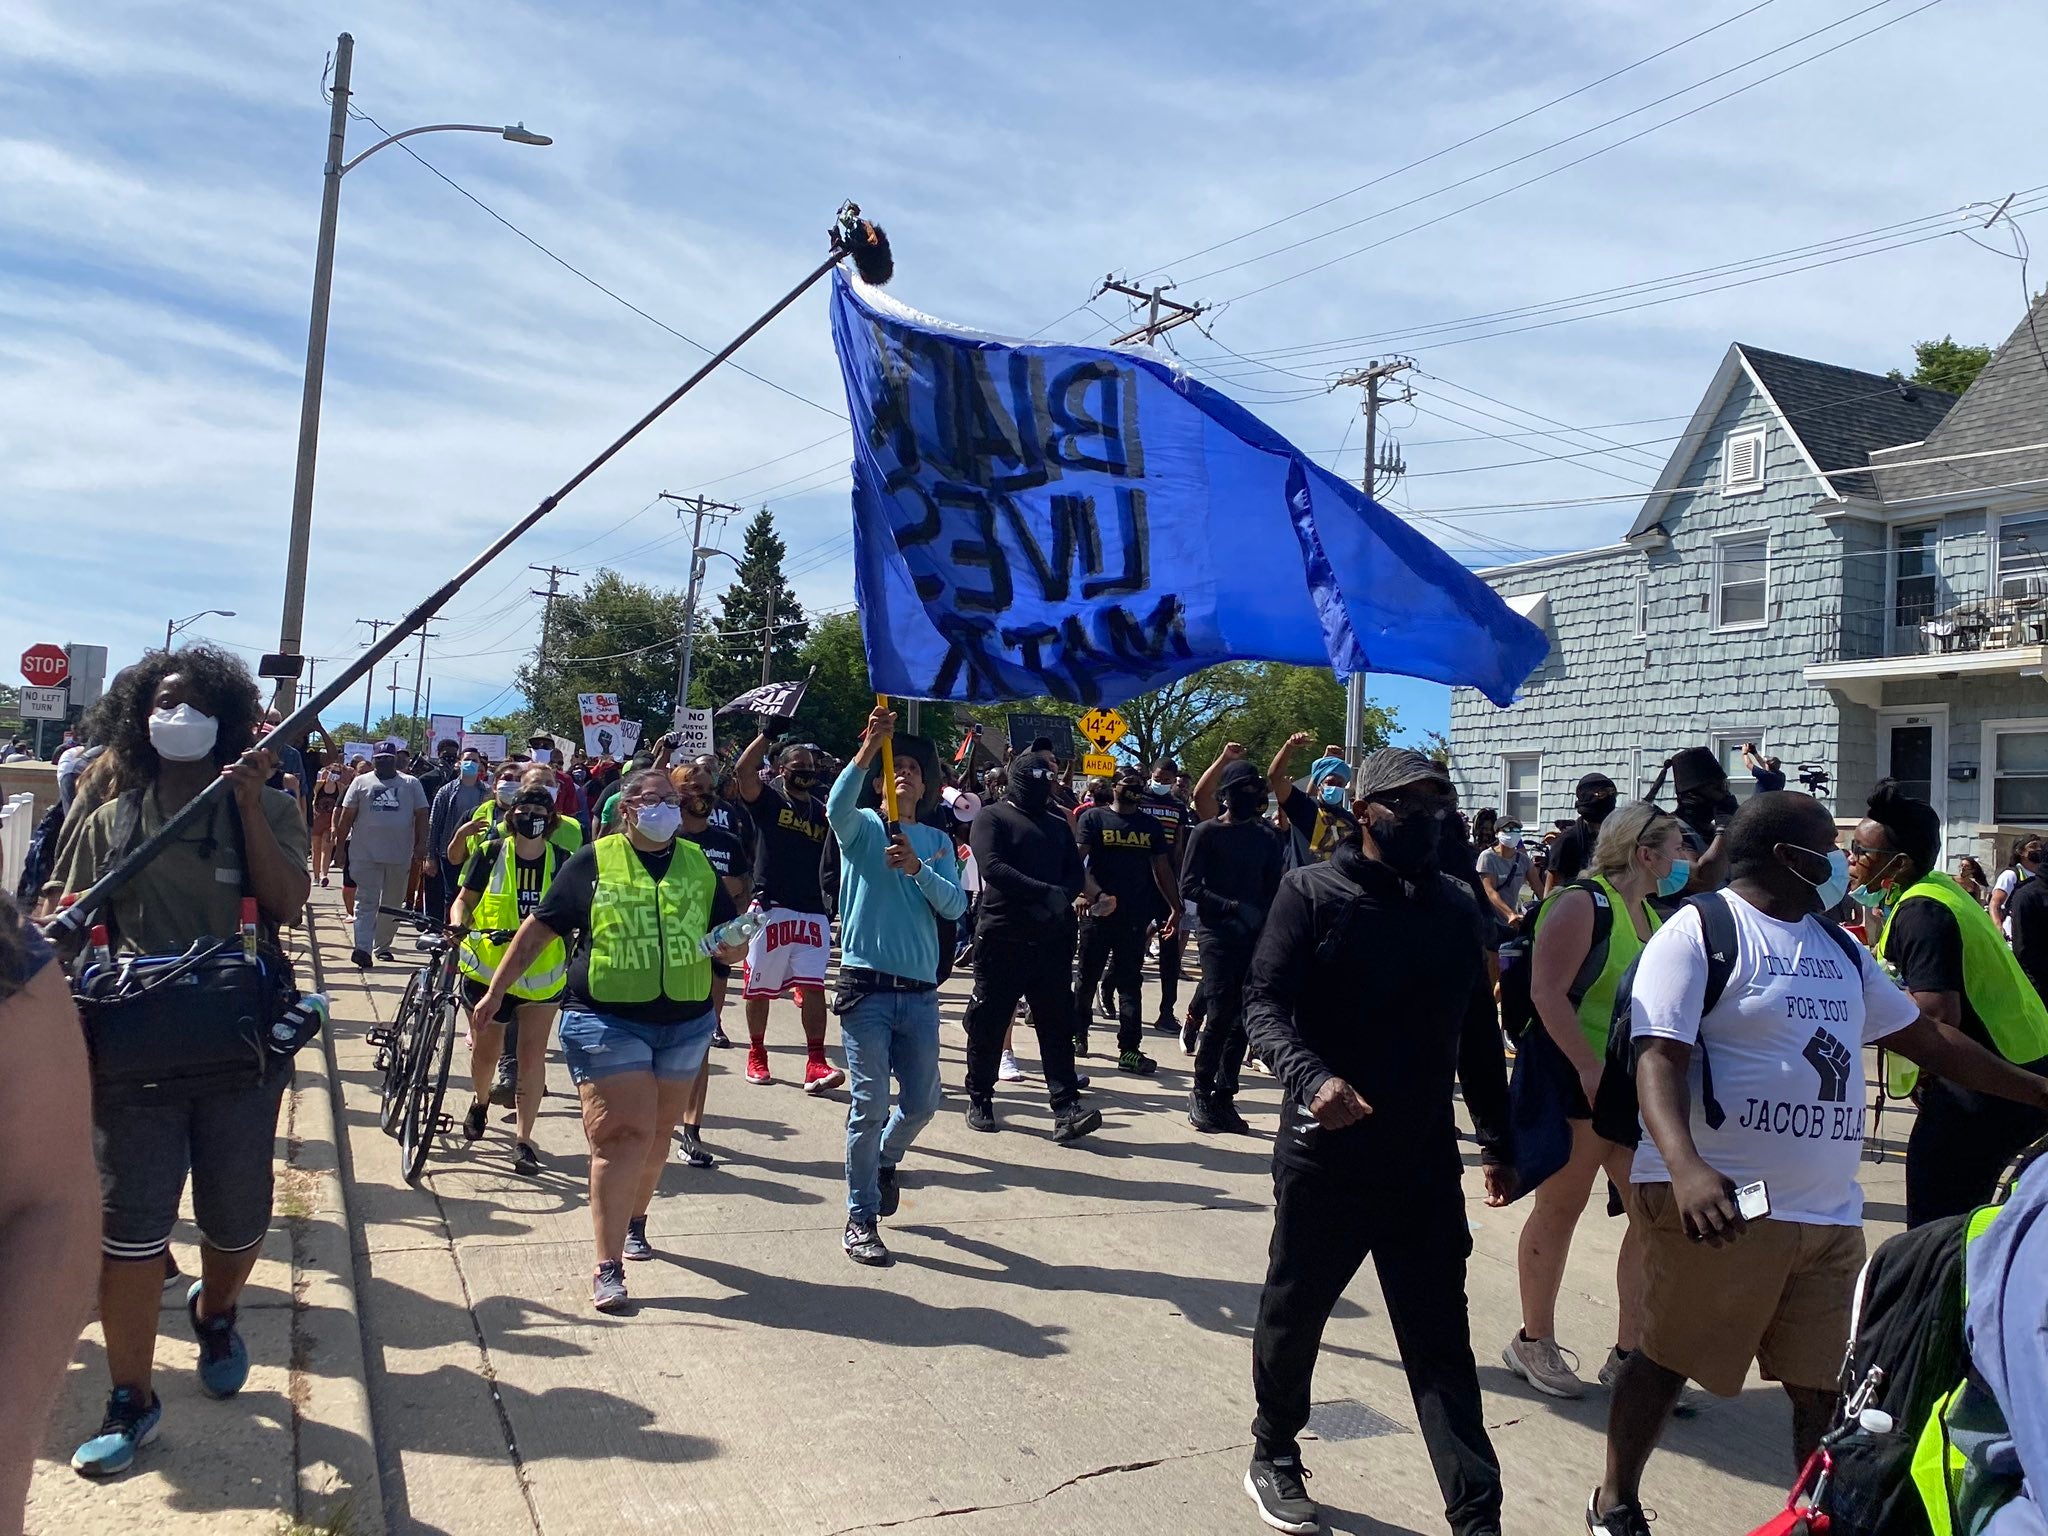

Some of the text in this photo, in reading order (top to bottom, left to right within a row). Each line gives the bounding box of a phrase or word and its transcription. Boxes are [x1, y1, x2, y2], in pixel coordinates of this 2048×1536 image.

[24, 656, 66, 674] STOP
[25, 691, 61, 702] NO LEFT
[580, 696, 594, 705] WE
[31, 703, 53, 711] TURN
[582, 714, 620, 726] BLOOD
[688, 712, 705, 721] NO
[1086, 761, 1113, 771] AHEAD
[372, 800, 399, 808] adidas
[1102, 829, 1151, 845] BLAK
[602, 906, 681, 938] LIVES
[765, 919, 823, 953] BULLS
[609, 935, 693, 970] MATTER
[1799, 957, 1843, 979] STAND
[1785, 996, 1848, 1022] FOR YOU
[1740, 1098, 1866, 1141] JACOB BLA
